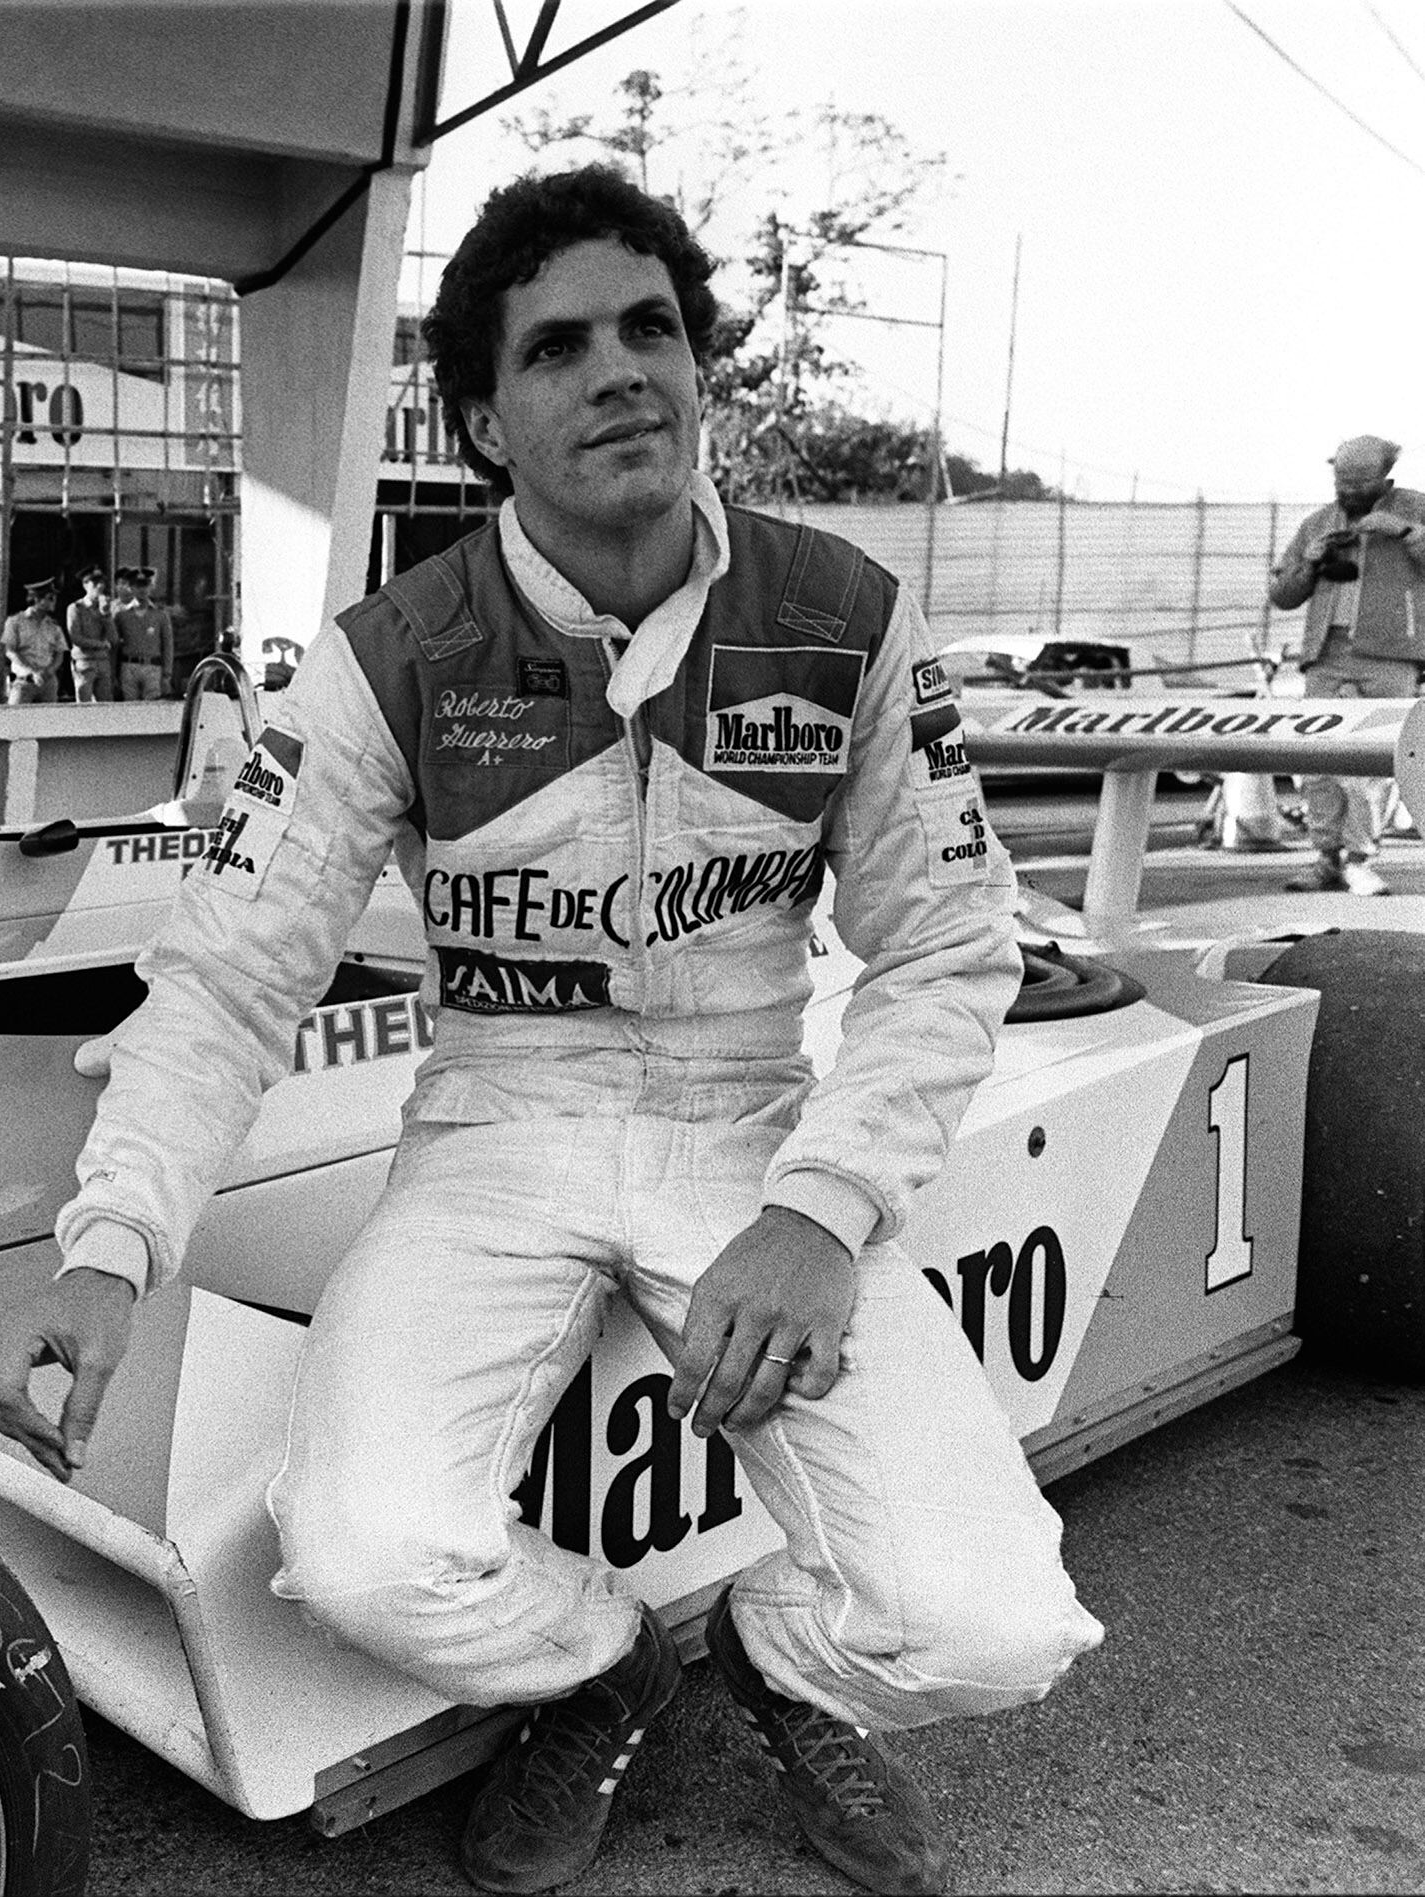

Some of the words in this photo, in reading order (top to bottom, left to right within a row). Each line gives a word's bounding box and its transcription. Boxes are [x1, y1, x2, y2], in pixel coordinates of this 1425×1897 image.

[435, 690, 535, 719] Roberto
[714, 706, 843, 752] Marlboro
[1005, 707, 1344, 735] Marlboro
[436, 723, 557, 750] Guerrero
[477, 750, 504, 766] A+
[714, 751, 747, 765] WORLD
[747, 752, 817, 766] CHAMPIONSHIP
[818, 753, 839, 766] TEAM
[424, 868, 549, 942] CAFE
[550, 888, 598, 930] DE
[600, 843, 821, 948] COLOMBIA
[1205, 1052, 1254, 1297] 1
